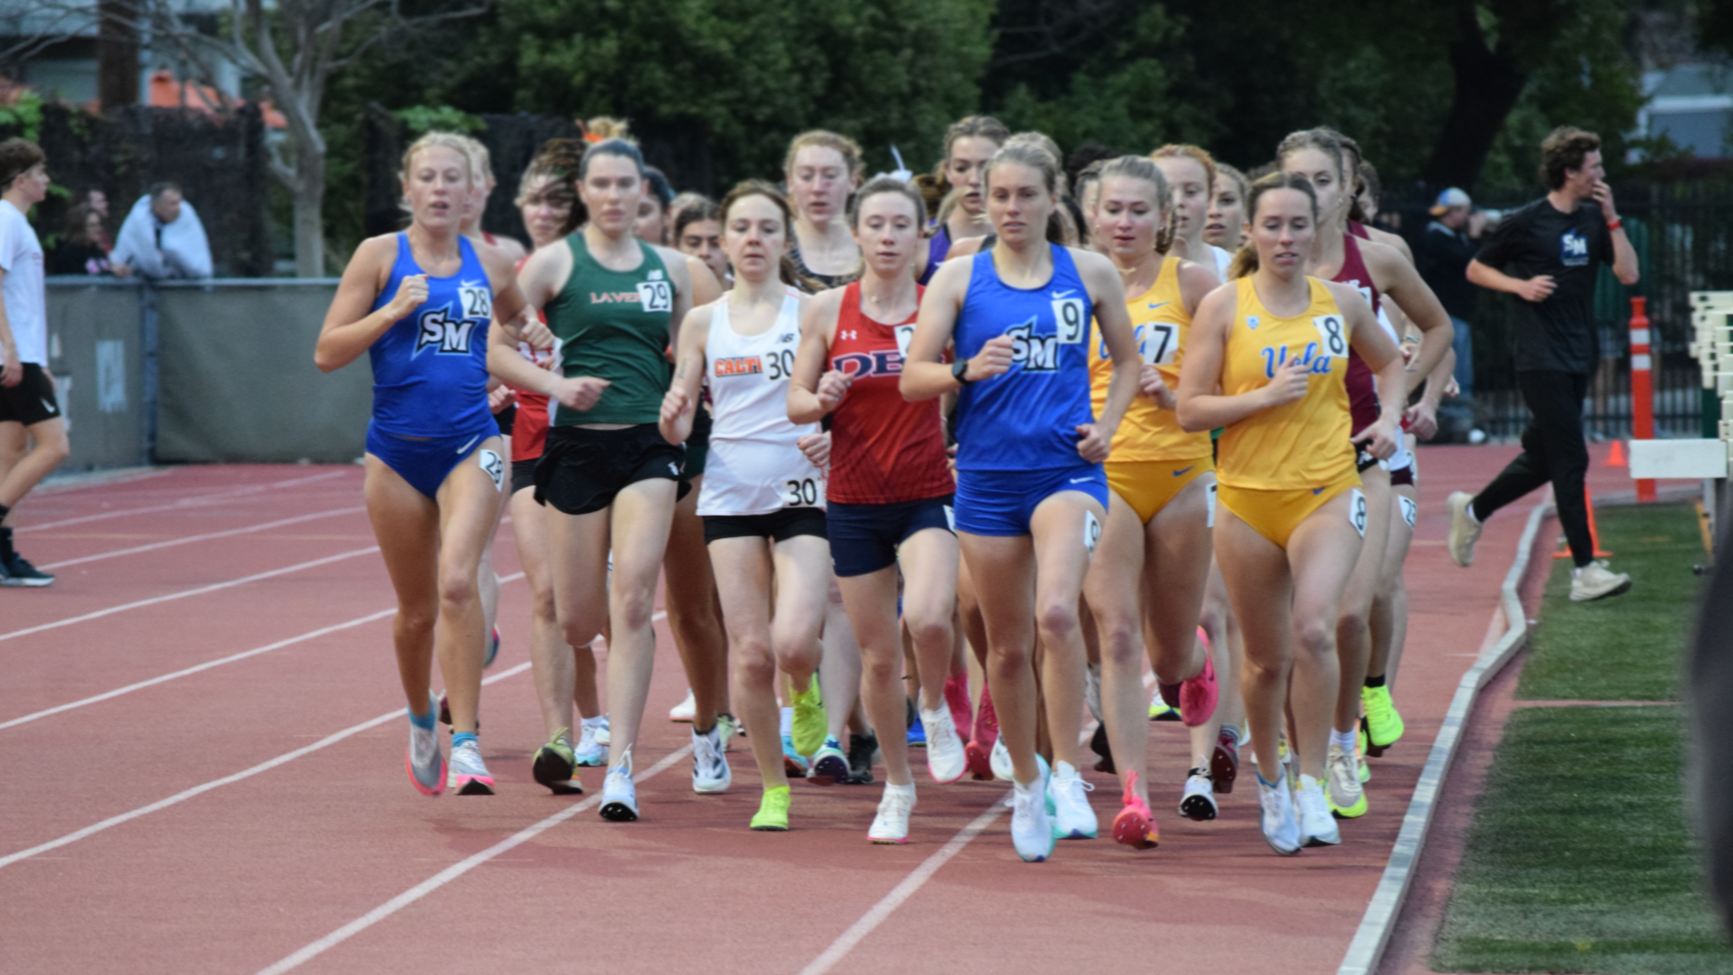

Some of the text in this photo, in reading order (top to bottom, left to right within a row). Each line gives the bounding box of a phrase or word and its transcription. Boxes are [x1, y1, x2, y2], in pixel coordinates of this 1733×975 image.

[464, 288, 490, 317] 28
[643, 283, 669, 310] 29
[417, 306, 477, 355] SM
[1062, 301, 1080, 342] 9
[1324, 316, 1344, 355] 8
[1153, 324, 1173, 364] 7
[766, 348, 795, 381] 30
[786, 477, 817, 507] 30
[1354, 495, 1368, 532] 8
